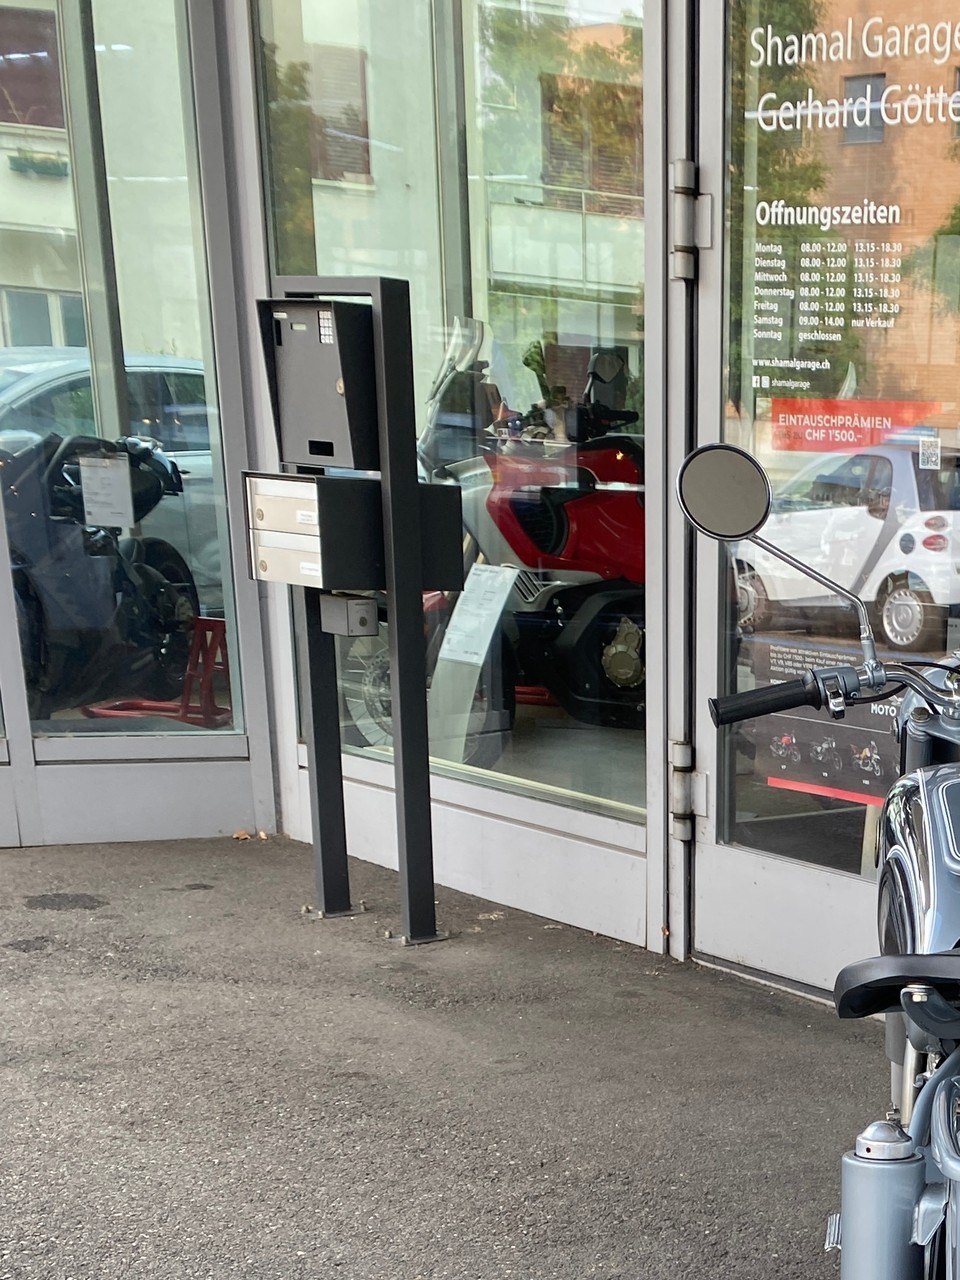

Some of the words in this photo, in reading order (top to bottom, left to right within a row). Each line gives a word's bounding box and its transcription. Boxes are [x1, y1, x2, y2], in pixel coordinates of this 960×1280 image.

[750, 17, 852, 68] Shamal
[757, 84, 872, 132] Gerhard
[755, 243, 782, 254] Montag
[801, 243, 822, 252] 08.00
[827, 243, 847, 252] 12.00
[855, 243, 875, 252] 13.15
[881, 243, 902, 252] 18.30
[755, 258, 786, 269] Dienstag
[801, 258, 821, 267] 08.00
[826, 258, 846, 267] 12.00
[854, 258, 874, 268] 13.15
[880, 258, 901, 268] 18.30
[754, 272, 787, 282] Mittwoch
[800, 272, 820, 282] 08.00
[826, 272, 846, 282] 12.00
[854, 272, 874, 282] 13.15
[880, 273, 900, 282] 18.30
[754, 287, 794, 299] Donnerstag
[800, 287, 820, 297] 08.00
[825, 287, 846, 297] 12.00
[853, 287, 873, 298] 13.15
[879, 288, 900, 298] 18.30
[754, 301, 778, 312] Freitag
[799, 302, 820, 312] 08.00
[825, 302, 845, 312] 12.00
[852, 302, 873, 312] 13.15
[879, 302, 899, 312] 18.30
[753, 316, 783, 326] Samstag
[799, 317, 819, 326] 09.00
[824, 317, 844, 326] 14.00
[865, 318, 895, 328] Verkauf
[753, 329, 782, 340] Sonntag
[799, 331, 841, 341] geschlossen
[752, 358, 830, 371] www.shamalgarage.ch
[772, 378, 810, 390] shamalgarage
[779, 413, 892, 429] EINTAUSCHPRÄMIEN
[805, 429, 826, 440] CHF
[870, 703, 896, 716] MOTO
